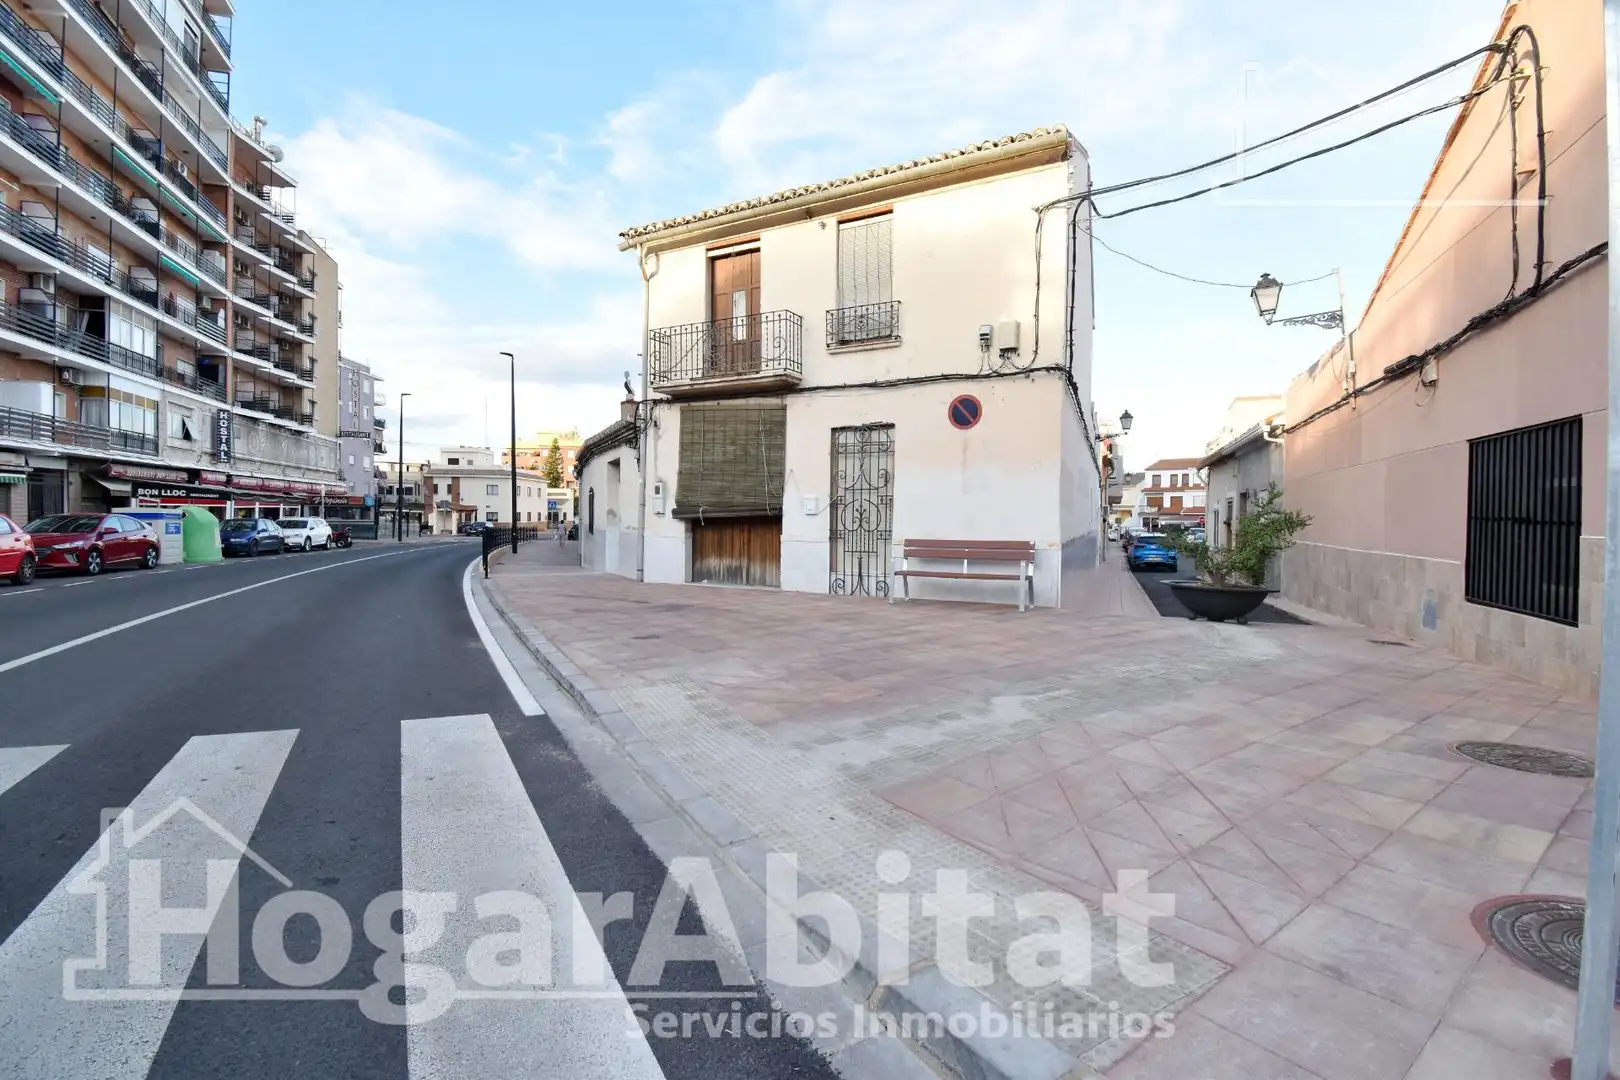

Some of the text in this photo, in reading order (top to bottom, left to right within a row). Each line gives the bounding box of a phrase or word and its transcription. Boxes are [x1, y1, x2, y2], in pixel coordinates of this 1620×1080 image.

[219, 411, 228, 459] HOSTAL
[137, 488, 159, 496] BON
[161, 489, 187, 497] LLOC
[313, 496, 348, 506] Vrginia
